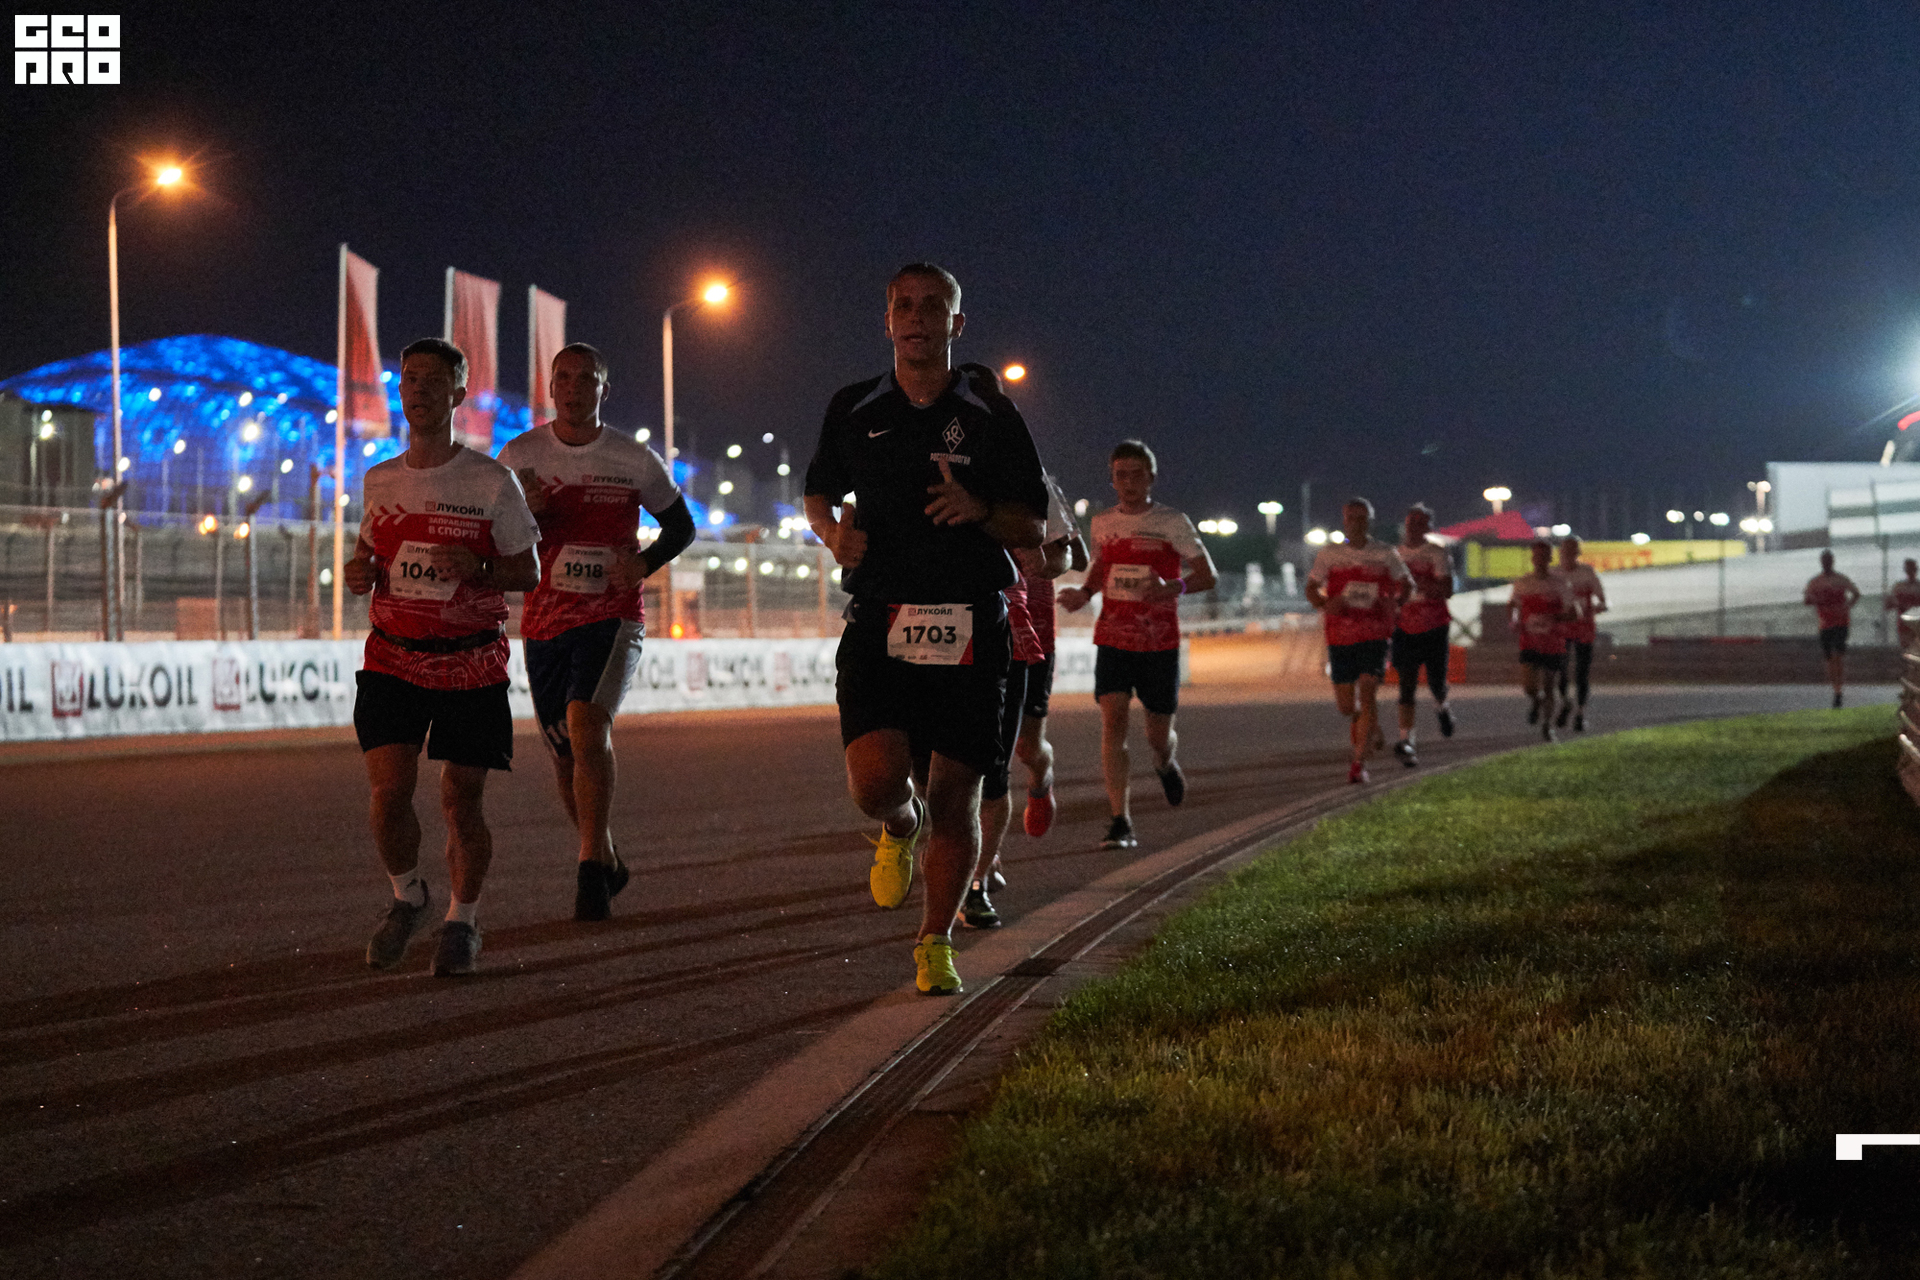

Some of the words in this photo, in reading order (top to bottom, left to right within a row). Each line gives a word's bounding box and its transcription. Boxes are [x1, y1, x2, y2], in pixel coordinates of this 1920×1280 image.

[436, 502, 484, 517] ЛУКОЙЛ
[438, 526, 479, 540] СПОРТЕ
[400, 562, 448, 582] 104
[565, 562, 603, 579] 1918
[916, 607, 953, 616] ЛУКОЙЛ
[903, 626, 957, 645] 1703
[87, 663, 197, 710] LUKOIL
